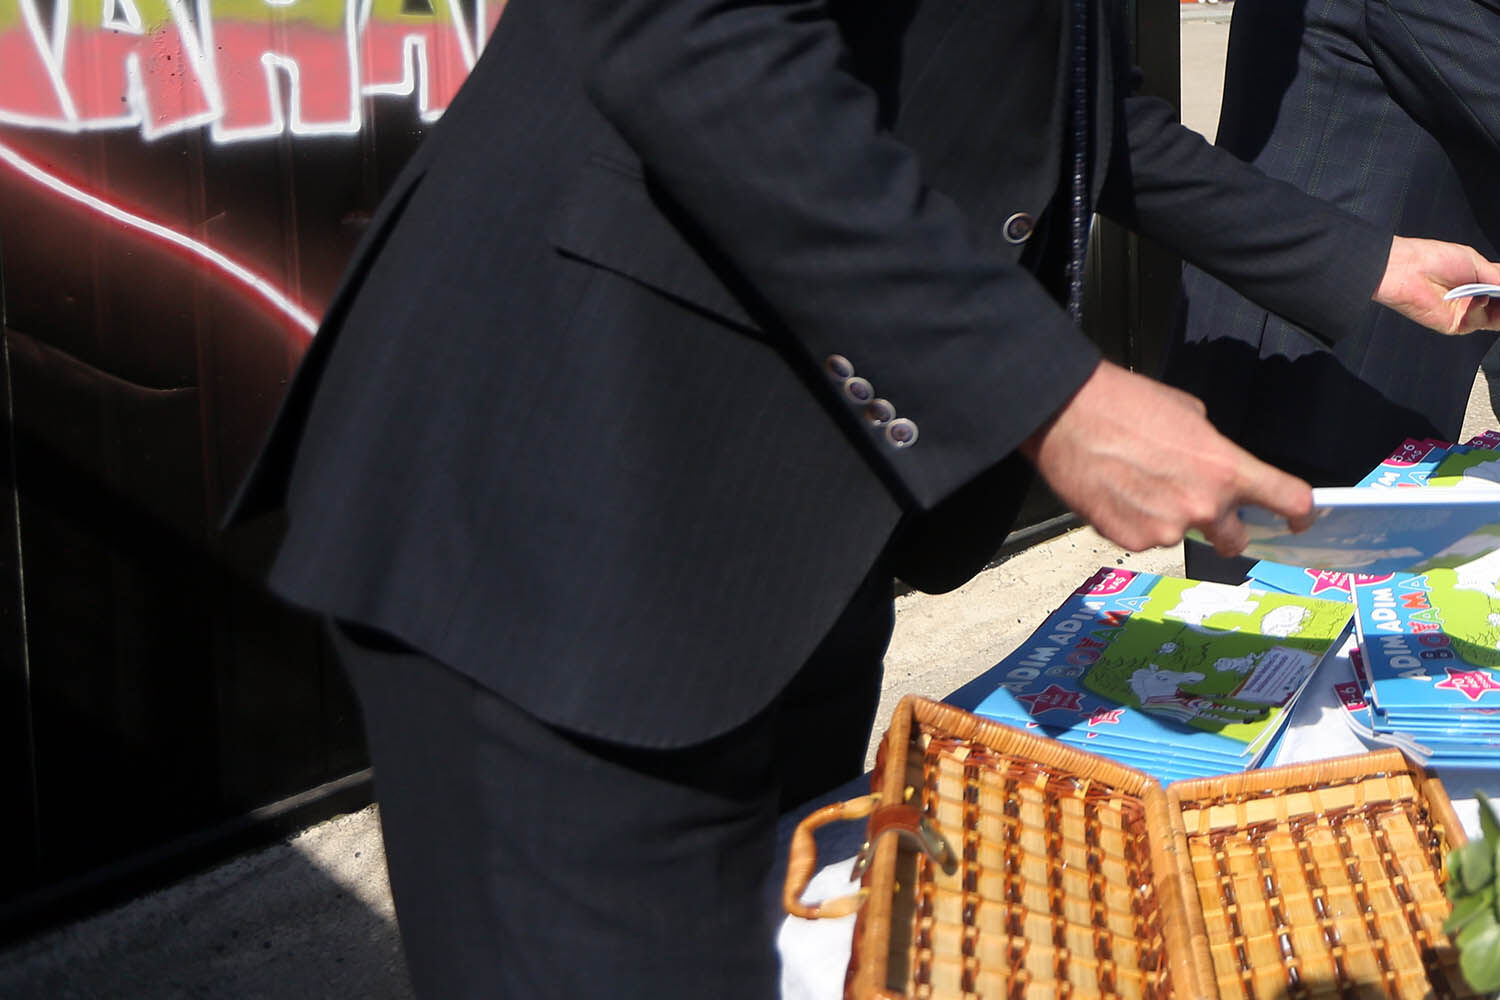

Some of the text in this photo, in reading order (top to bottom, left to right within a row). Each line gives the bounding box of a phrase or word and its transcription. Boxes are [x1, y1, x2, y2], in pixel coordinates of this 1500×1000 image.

[1391, 443, 1415, 463] 5-6
[998, 601, 1106, 693] ADIM ADIM
[1043, 595, 1153, 679] BOYAMA
[1371, 587, 1433, 681] ADIM ADIM
[1398, 574, 1456, 661] BOYAMA
